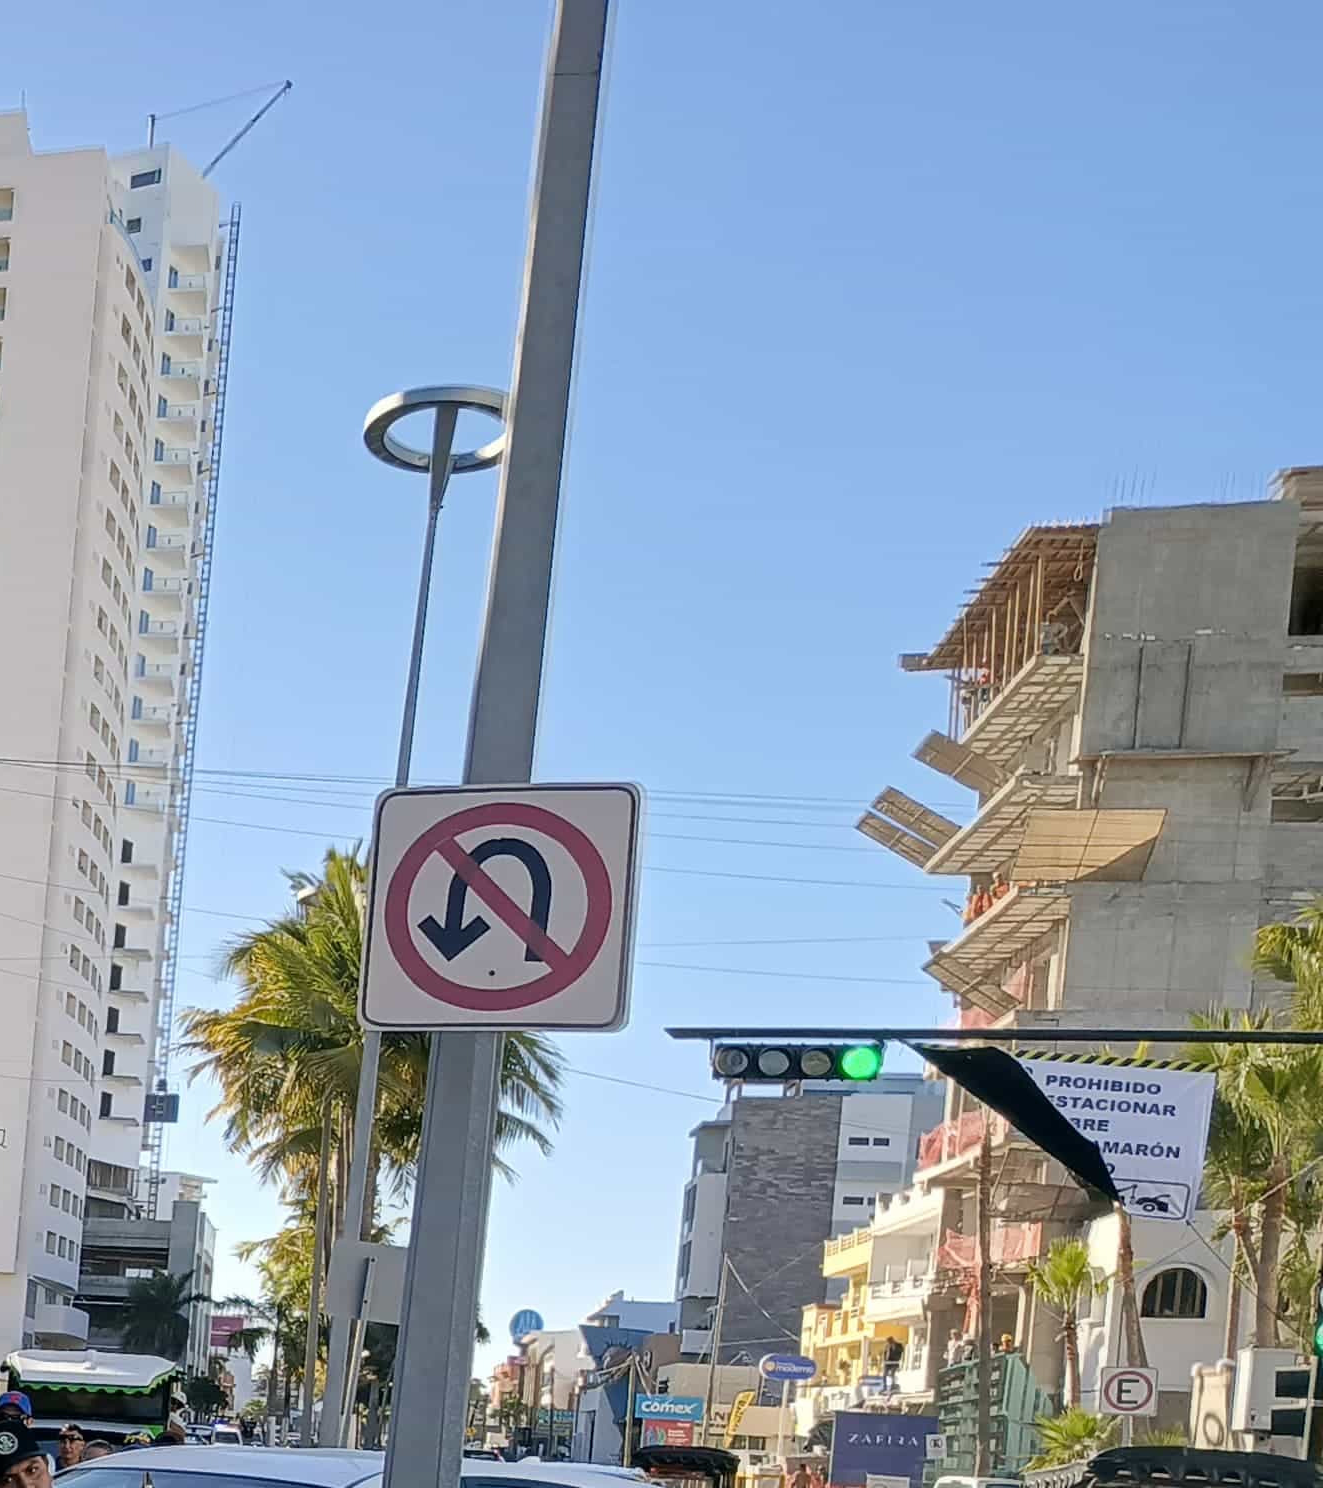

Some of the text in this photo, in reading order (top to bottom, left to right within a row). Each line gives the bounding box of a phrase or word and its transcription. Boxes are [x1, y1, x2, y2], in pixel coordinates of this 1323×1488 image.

[1045, 1074, 1162, 1096] PROHIBIDO
[1047, 1094, 1177, 1117] STACIONAR
[1071, 1117, 1110, 1132] BRE
[1093, 1141, 1180, 1159] MARÓN
